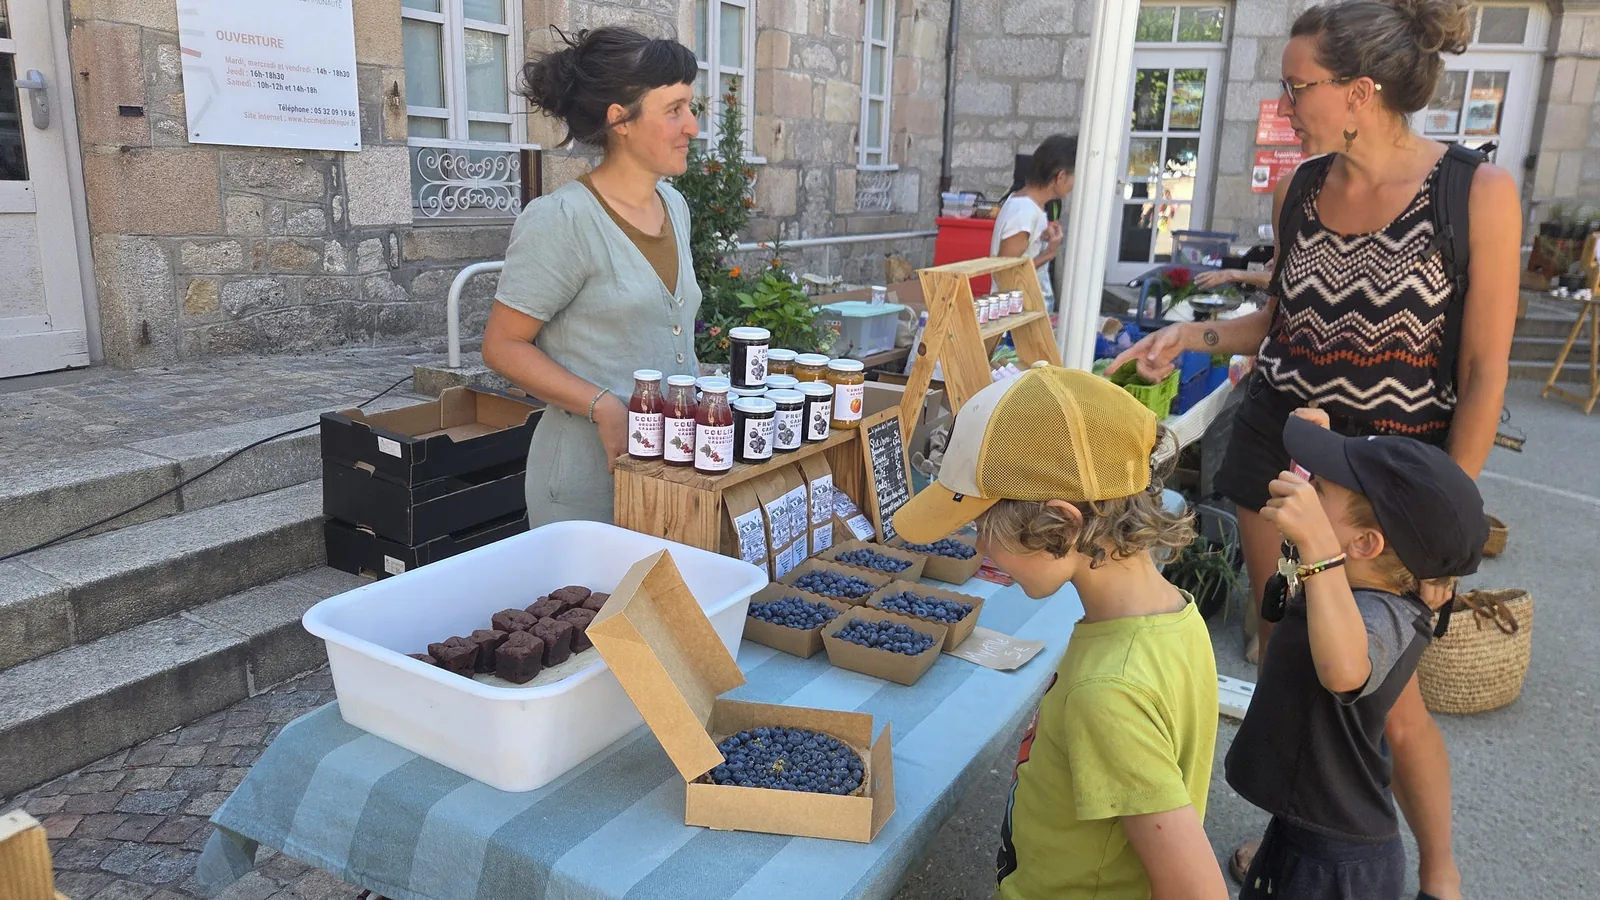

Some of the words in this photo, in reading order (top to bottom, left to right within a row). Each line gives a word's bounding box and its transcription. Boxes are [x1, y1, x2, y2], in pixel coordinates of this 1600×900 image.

[216, 29, 284, 49] OUVERTURE
[225, 56, 247, 68] Mardi,
[248, 59, 277, 69] mercredi
[277, 62, 285, 71] et
[285, 63, 312, 74] vendredi
[316, 67, 328, 76] 14h
[332, 69, 350, 78] 18h30
[226, 66, 245, 77] Jeudi
[250, 69, 285, 81] 16h-18h30
[226, 78, 252, 88] Samedi
[257, 81, 284, 92] 10h-12h
[284, 84, 292, 92] et
[292, 84, 318, 94] 14h-18h
[243, 111, 257, 120] Site
[258, 112, 283, 122] internet
[278, 103, 310, 115] Téléphone
[313, 107, 322, 115] 05
[322, 108, 331, 116] 32
[331, 108, 339, 116] 09
[340, 109, 348, 117] 19
